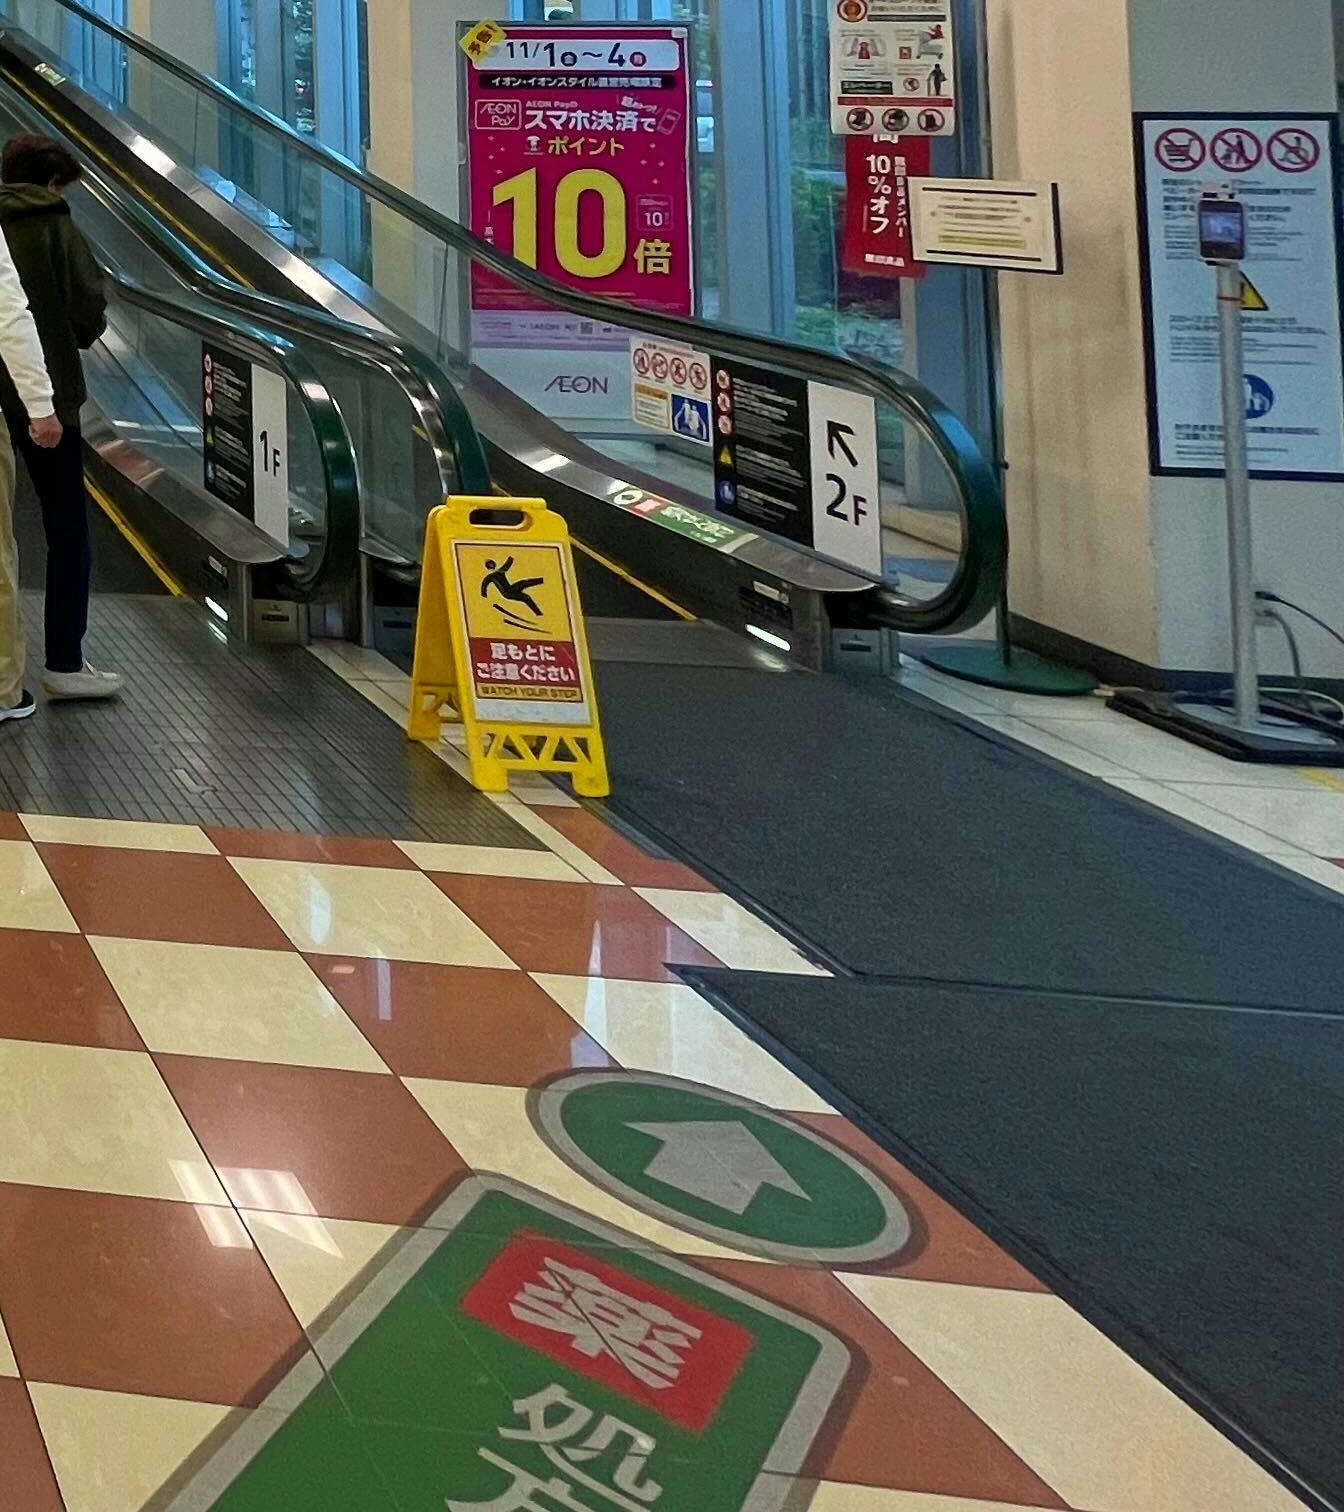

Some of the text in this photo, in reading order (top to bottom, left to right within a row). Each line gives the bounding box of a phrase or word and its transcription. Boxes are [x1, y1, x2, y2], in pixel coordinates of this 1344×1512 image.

[524, 110, 657, 132] スマホ決済で
[548, 136, 625, 156] ポイント
[493, 168, 626, 278] 10
[633, 239, 673, 275] 倍
[825, 473, 868, 526] 2F
[490, 642, 556, 661] 足もとに
[476, 662, 575, 682] ご注意ください
